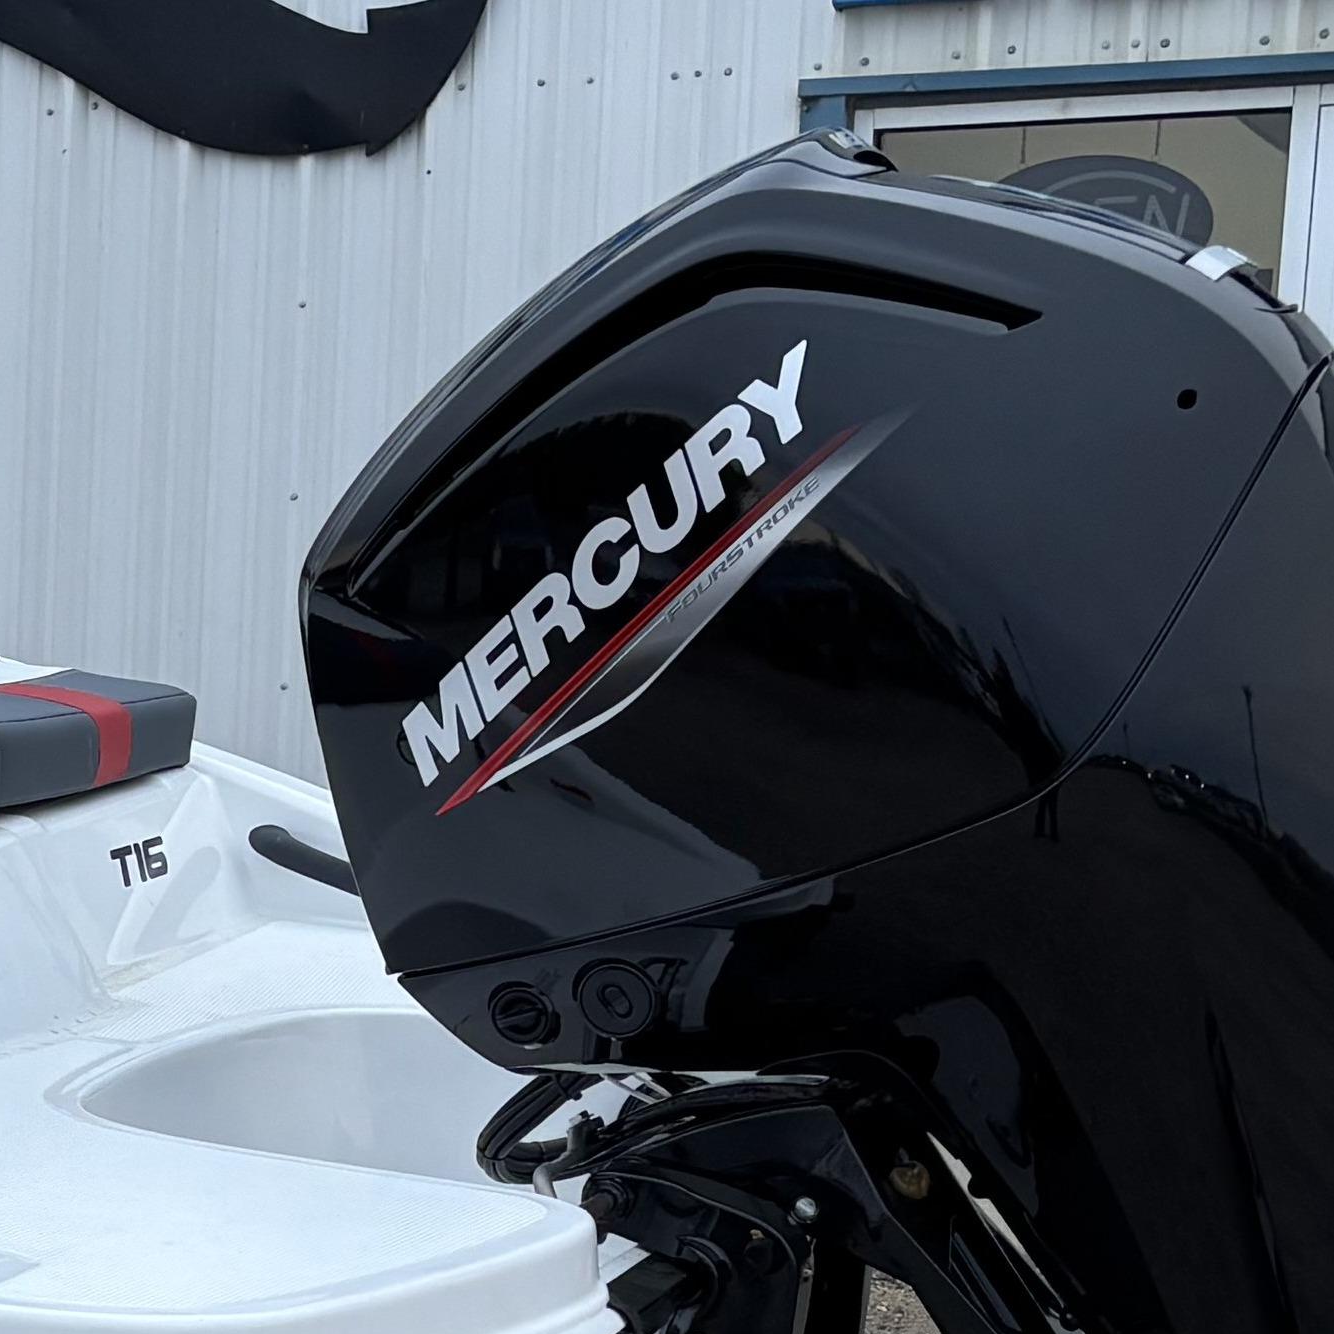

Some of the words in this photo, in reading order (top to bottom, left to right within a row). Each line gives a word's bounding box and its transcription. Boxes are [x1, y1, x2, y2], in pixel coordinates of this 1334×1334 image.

[402, 339, 808, 787] MERCURY
[665, 475, 821, 622] FOURSTROKE
[110, 835, 168, 888] T16
